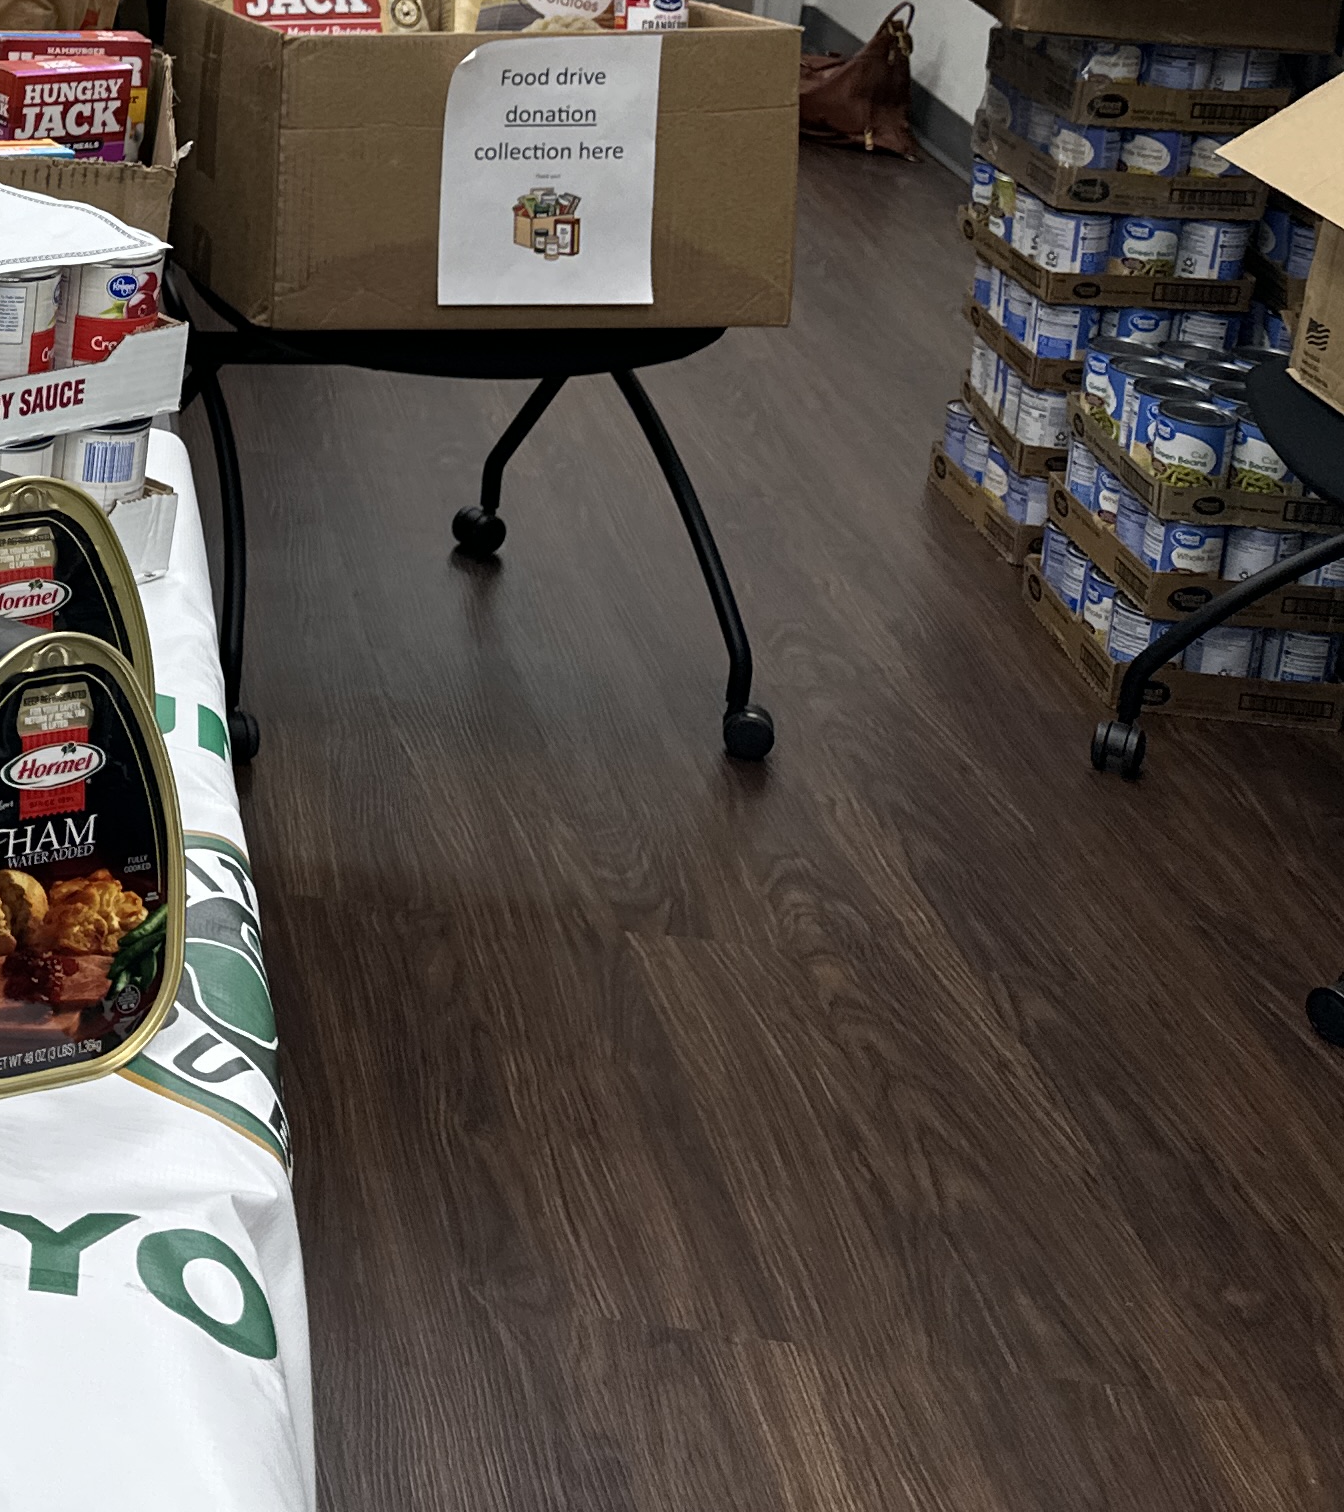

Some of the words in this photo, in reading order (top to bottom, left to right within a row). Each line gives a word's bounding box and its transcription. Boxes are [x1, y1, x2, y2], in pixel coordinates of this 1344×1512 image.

[47, 47, 105, 55] HAMBURGER
[501, 68, 549, 86] Food
[556, 67, 606, 85] drive
[24, 79, 124, 105] HUNGRY
[14, 100, 121, 139] JACK
[505, 105, 596, 123] donation
[73, 141, 99, 149] MEALS
[474, 142, 571, 161] collection
[579, 142, 624, 160] here
[19, 379, 86, 417] SAUCE
[17, 753, 94, 780] Hormel
[7, 854, 53, 869] WATER
[52, 843, 95, 864] ADDED
[127, 854, 148, 864] FULLY
